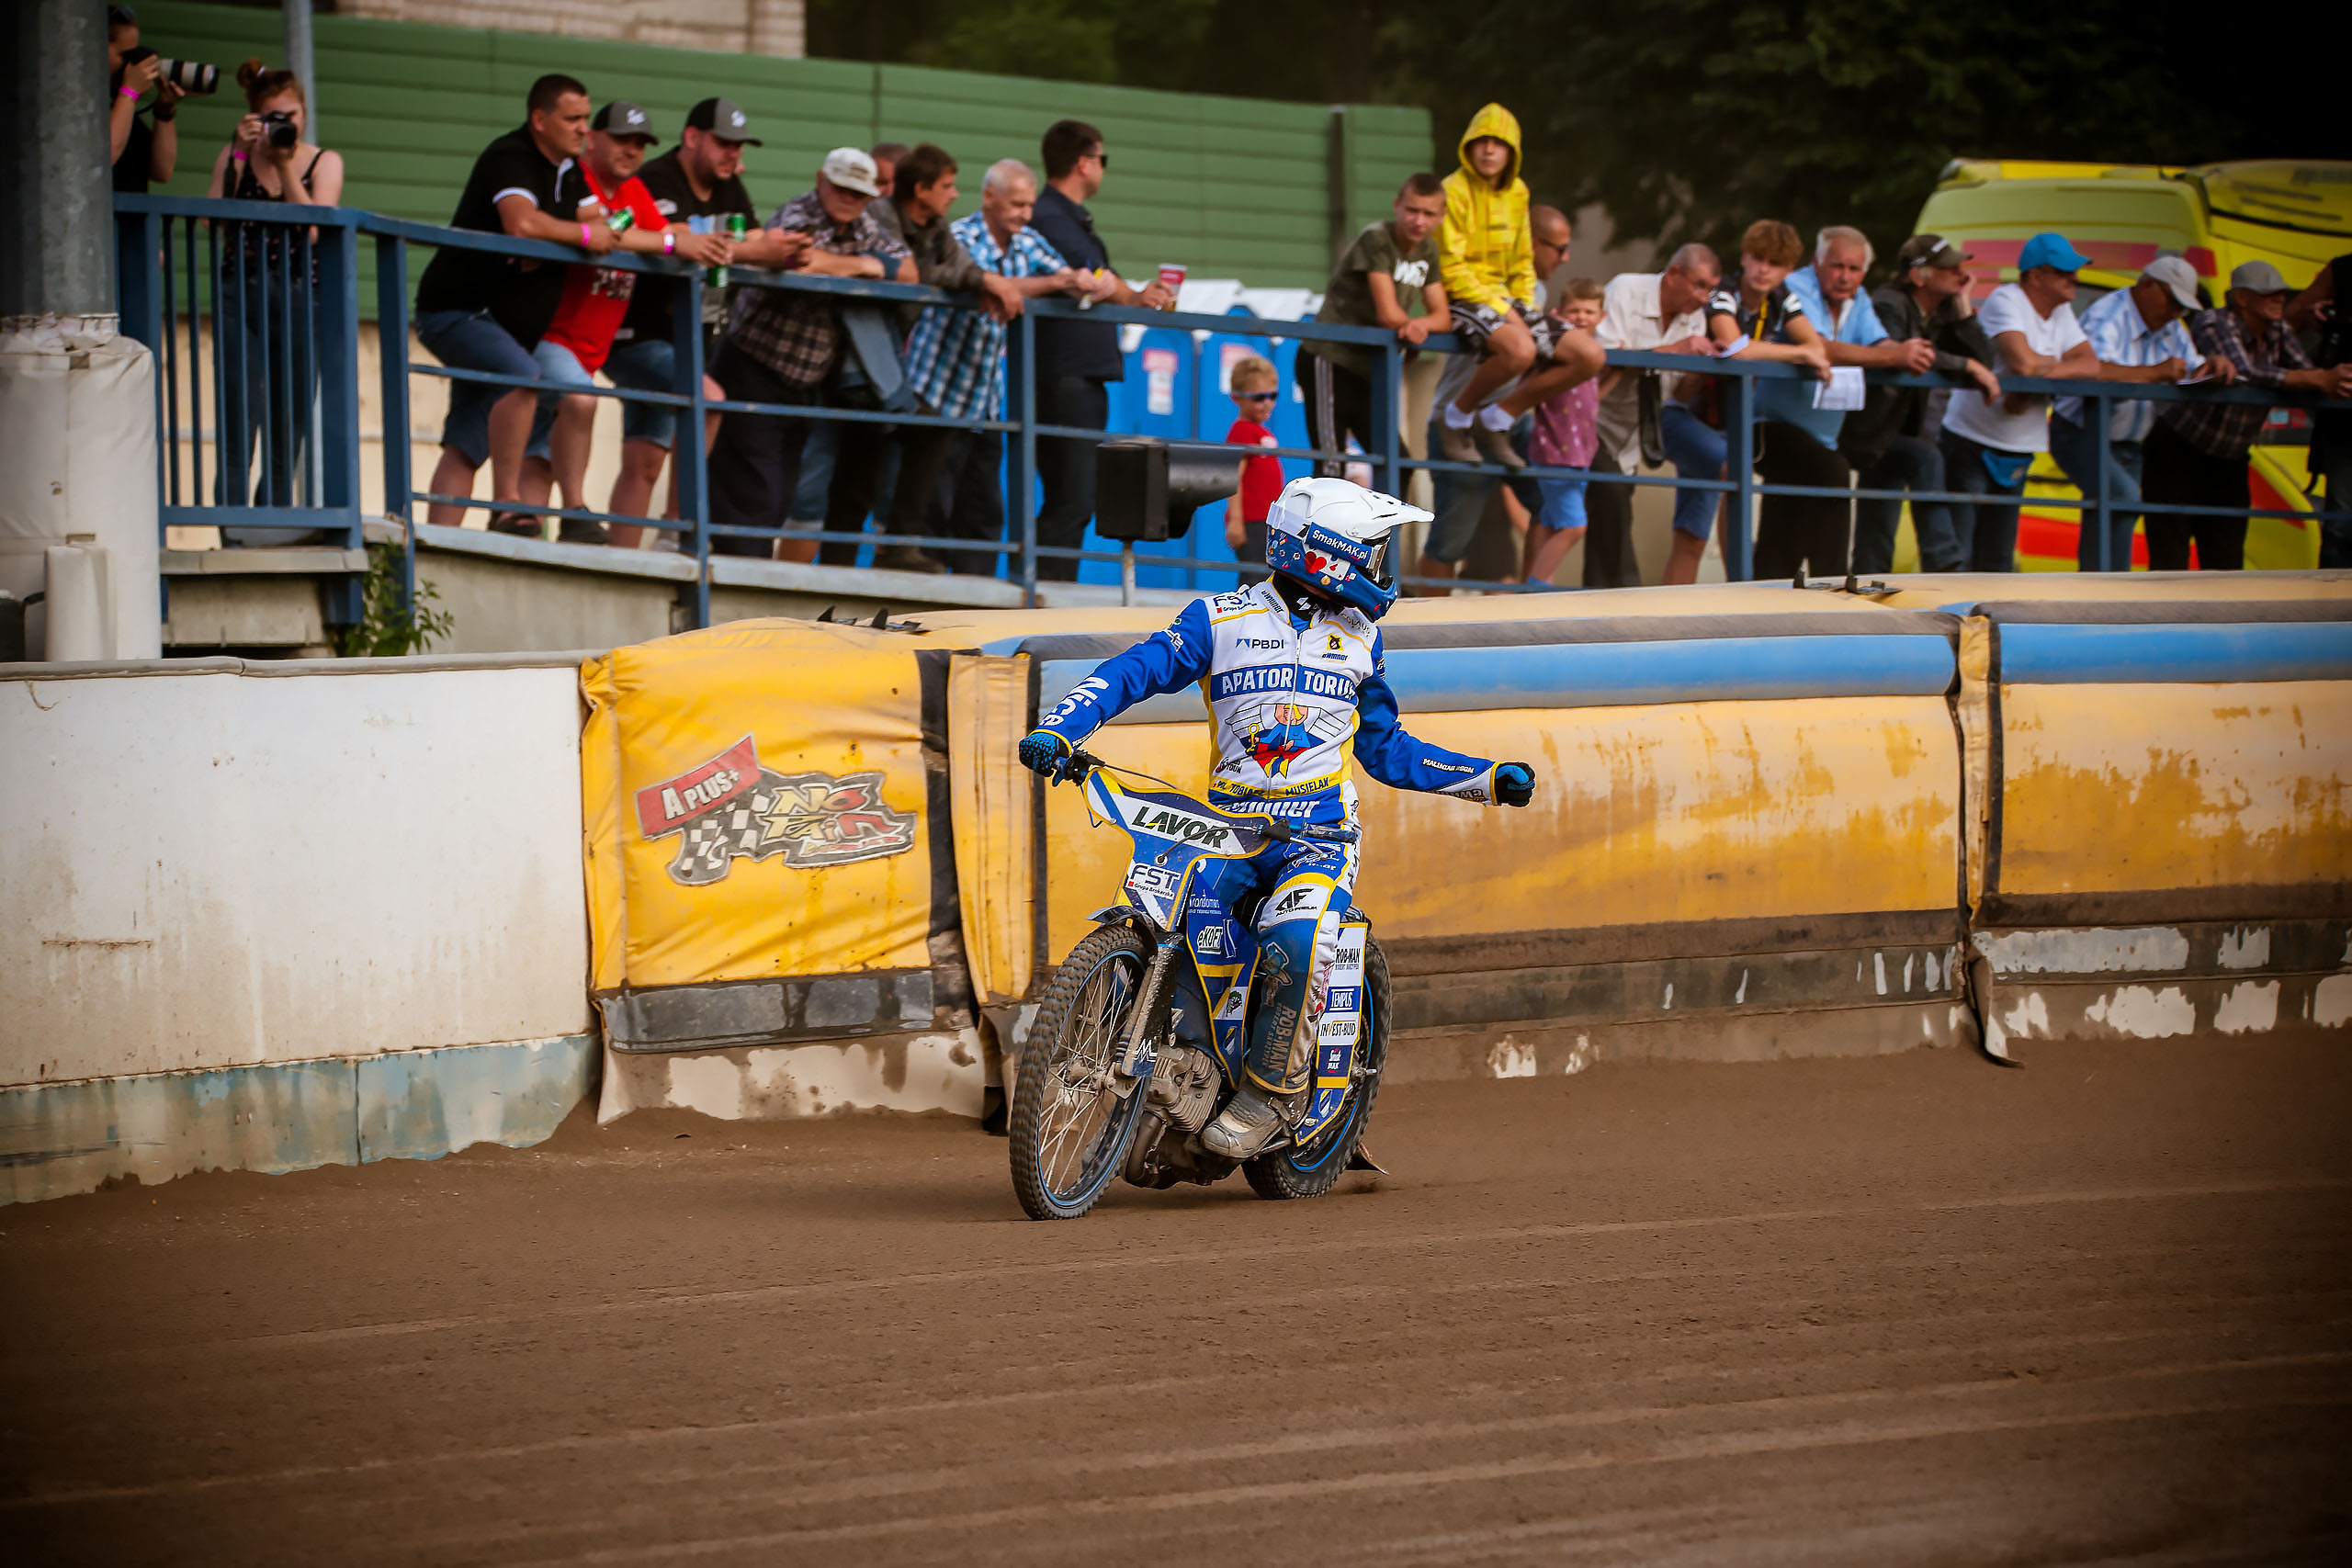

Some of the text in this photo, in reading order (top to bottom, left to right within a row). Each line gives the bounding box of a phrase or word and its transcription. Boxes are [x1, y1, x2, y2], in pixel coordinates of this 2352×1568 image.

[1312, 528, 1369, 560] SmakMAK.pl
[1251, 638, 1284, 649] PBDI
[1222, 667, 1294, 694] APATOR
[1132, 807, 1229, 849] LAVOR
[1130, 864, 1180, 889] FST
[1269, 1006, 1297, 1072] ROB-MAN
[1320, 1021, 1357, 1037] INVEST-BUD
